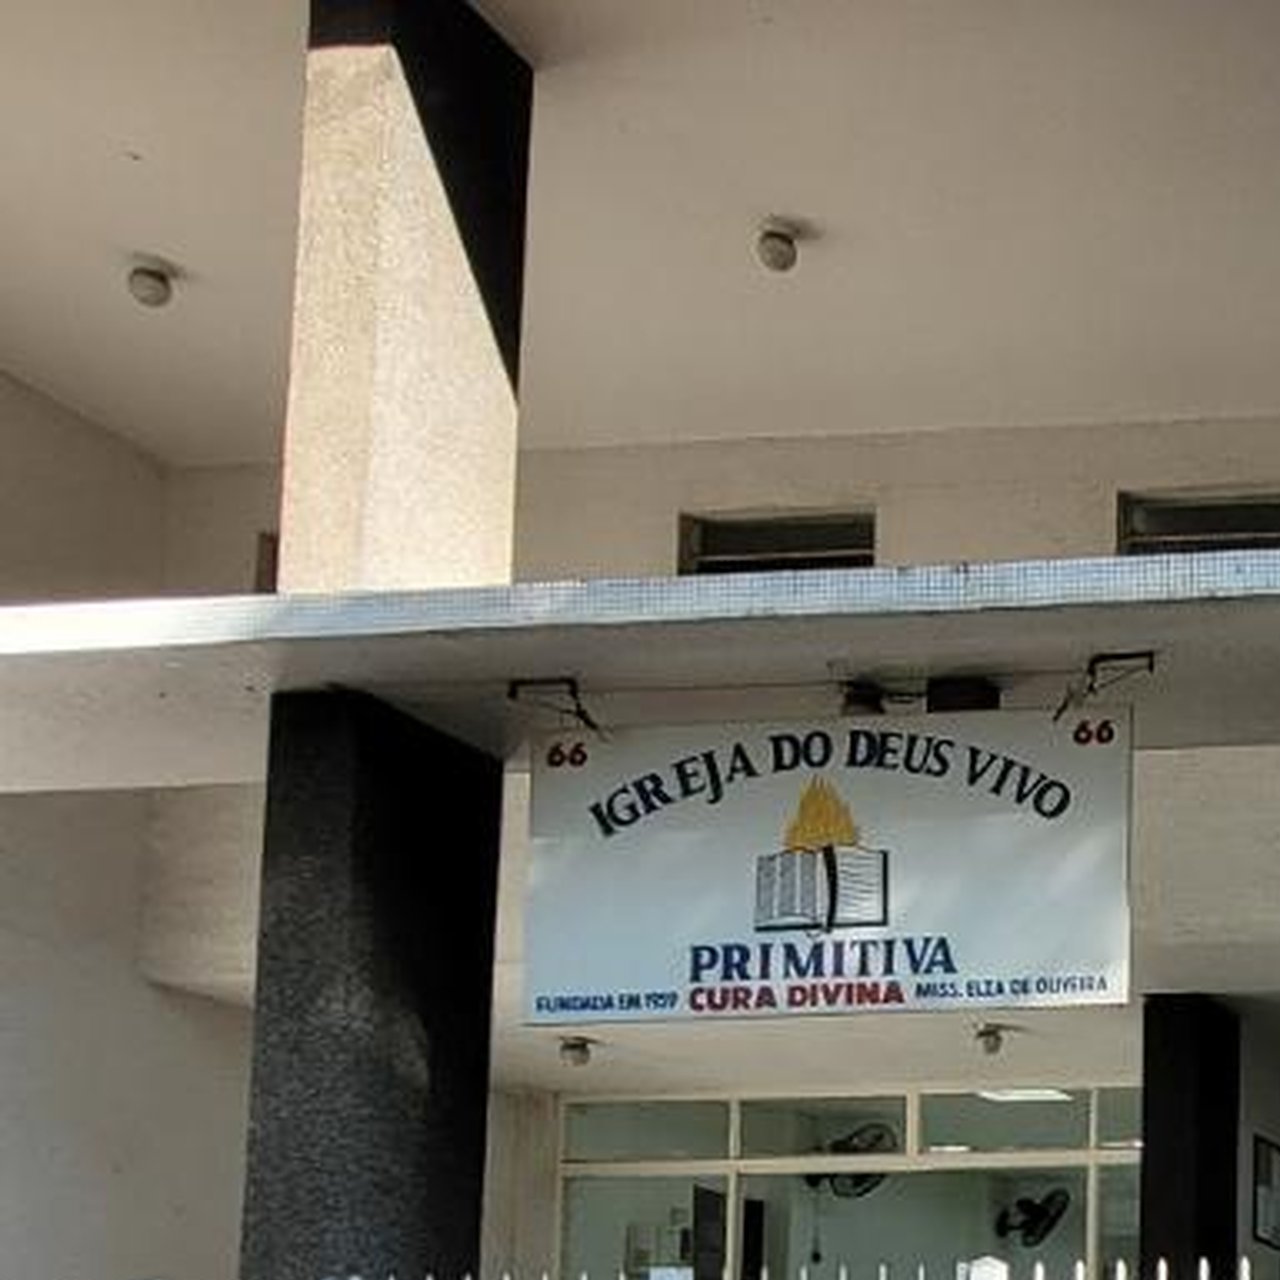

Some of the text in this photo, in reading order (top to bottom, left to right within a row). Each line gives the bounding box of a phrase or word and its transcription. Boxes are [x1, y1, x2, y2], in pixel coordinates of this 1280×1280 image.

[1073, 719, 1115, 745] 66
[547, 742, 588, 768] 66
[589, 729, 1072, 837] IGREJA DO DEUS VIVO
[689, 936, 958, 983] PRIMITIVA
[689, 980, 905, 1012] CURA DIVINA
[914, 981, 964, 999] MISS.
[1010, 978, 1029, 995] DE
[536, 993, 614, 1013] FUNDADA
[618, 992, 641, 1010] EM
